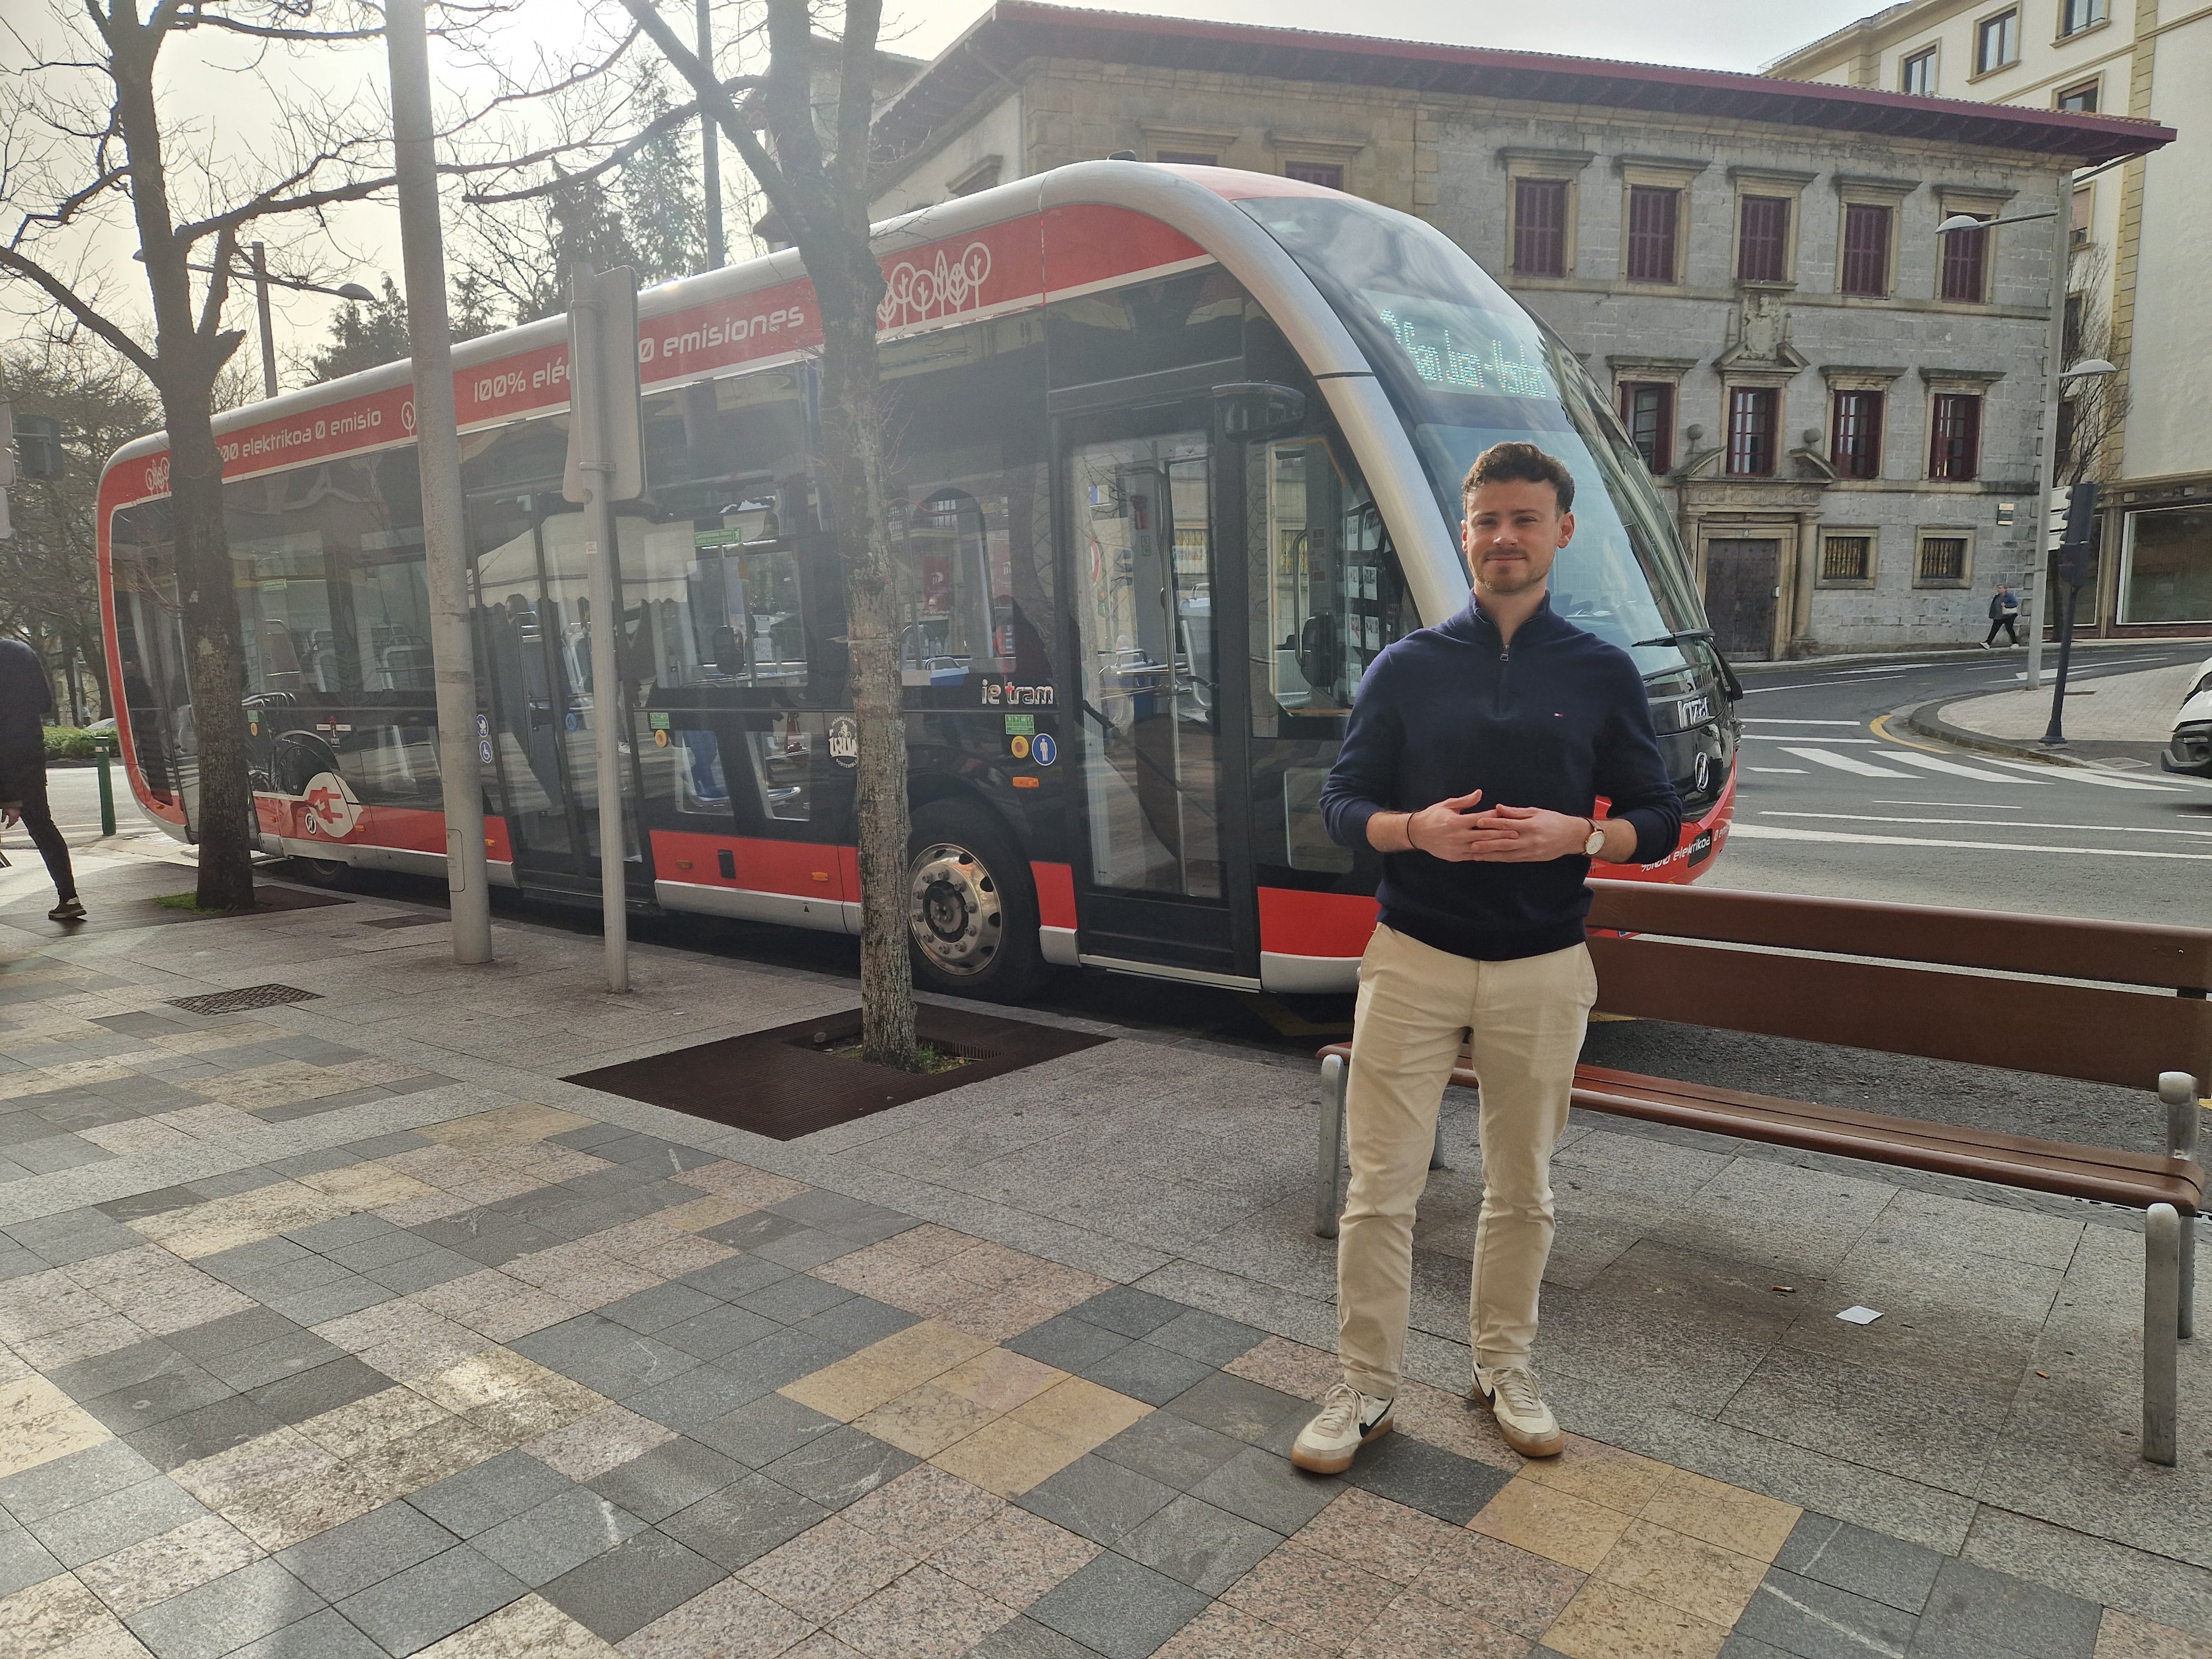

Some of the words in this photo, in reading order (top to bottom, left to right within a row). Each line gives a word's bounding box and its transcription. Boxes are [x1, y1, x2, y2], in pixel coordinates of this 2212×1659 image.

[474, 369, 526, 403] 100%
[663, 306, 805, 357] emisiones
[242, 428, 312, 458] elektrikoa
[331, 408, 382, 436] emisio
[1004, 681, 1054, 706] tram
